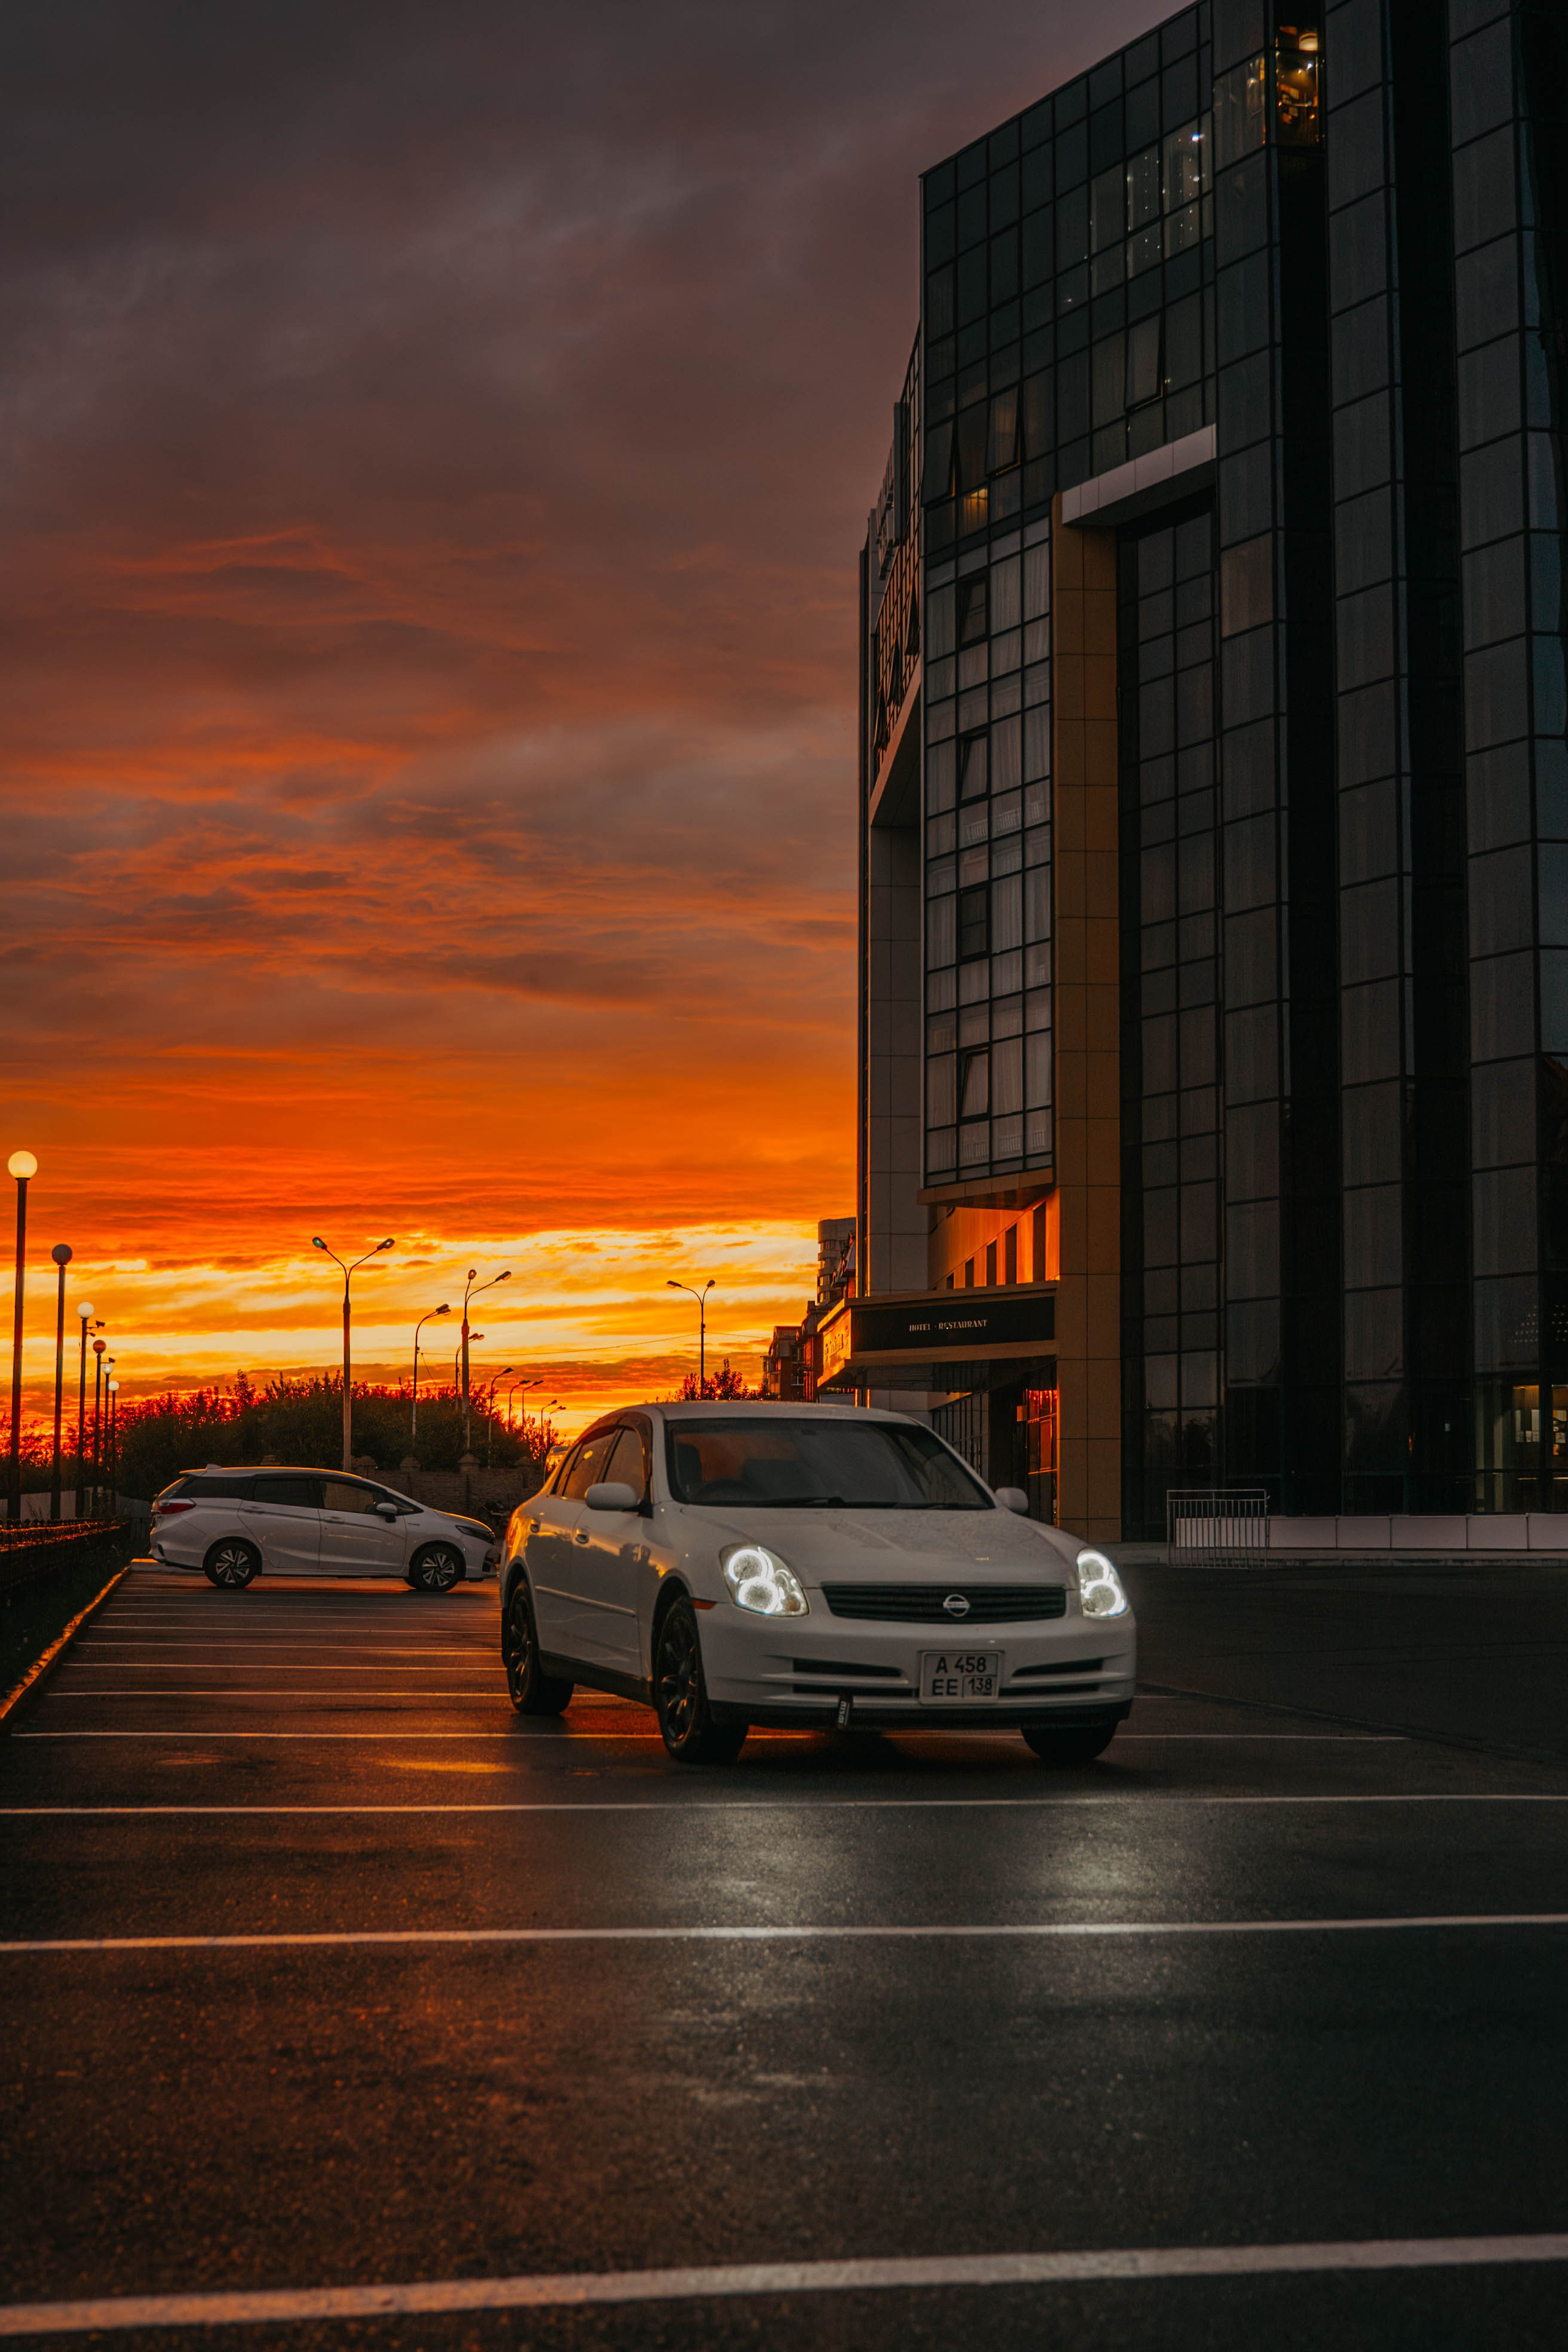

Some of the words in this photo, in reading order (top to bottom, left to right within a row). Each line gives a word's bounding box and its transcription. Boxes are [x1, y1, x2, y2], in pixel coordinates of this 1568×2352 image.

[938, 1319, 987, 1330] RESTAURANT
[936, 1656, 948, 1673] A
[954, 1656, 986, 1673] 458
[932, 1678, 957, 1695] EE
[968, 1678, 992, 1691] 138
